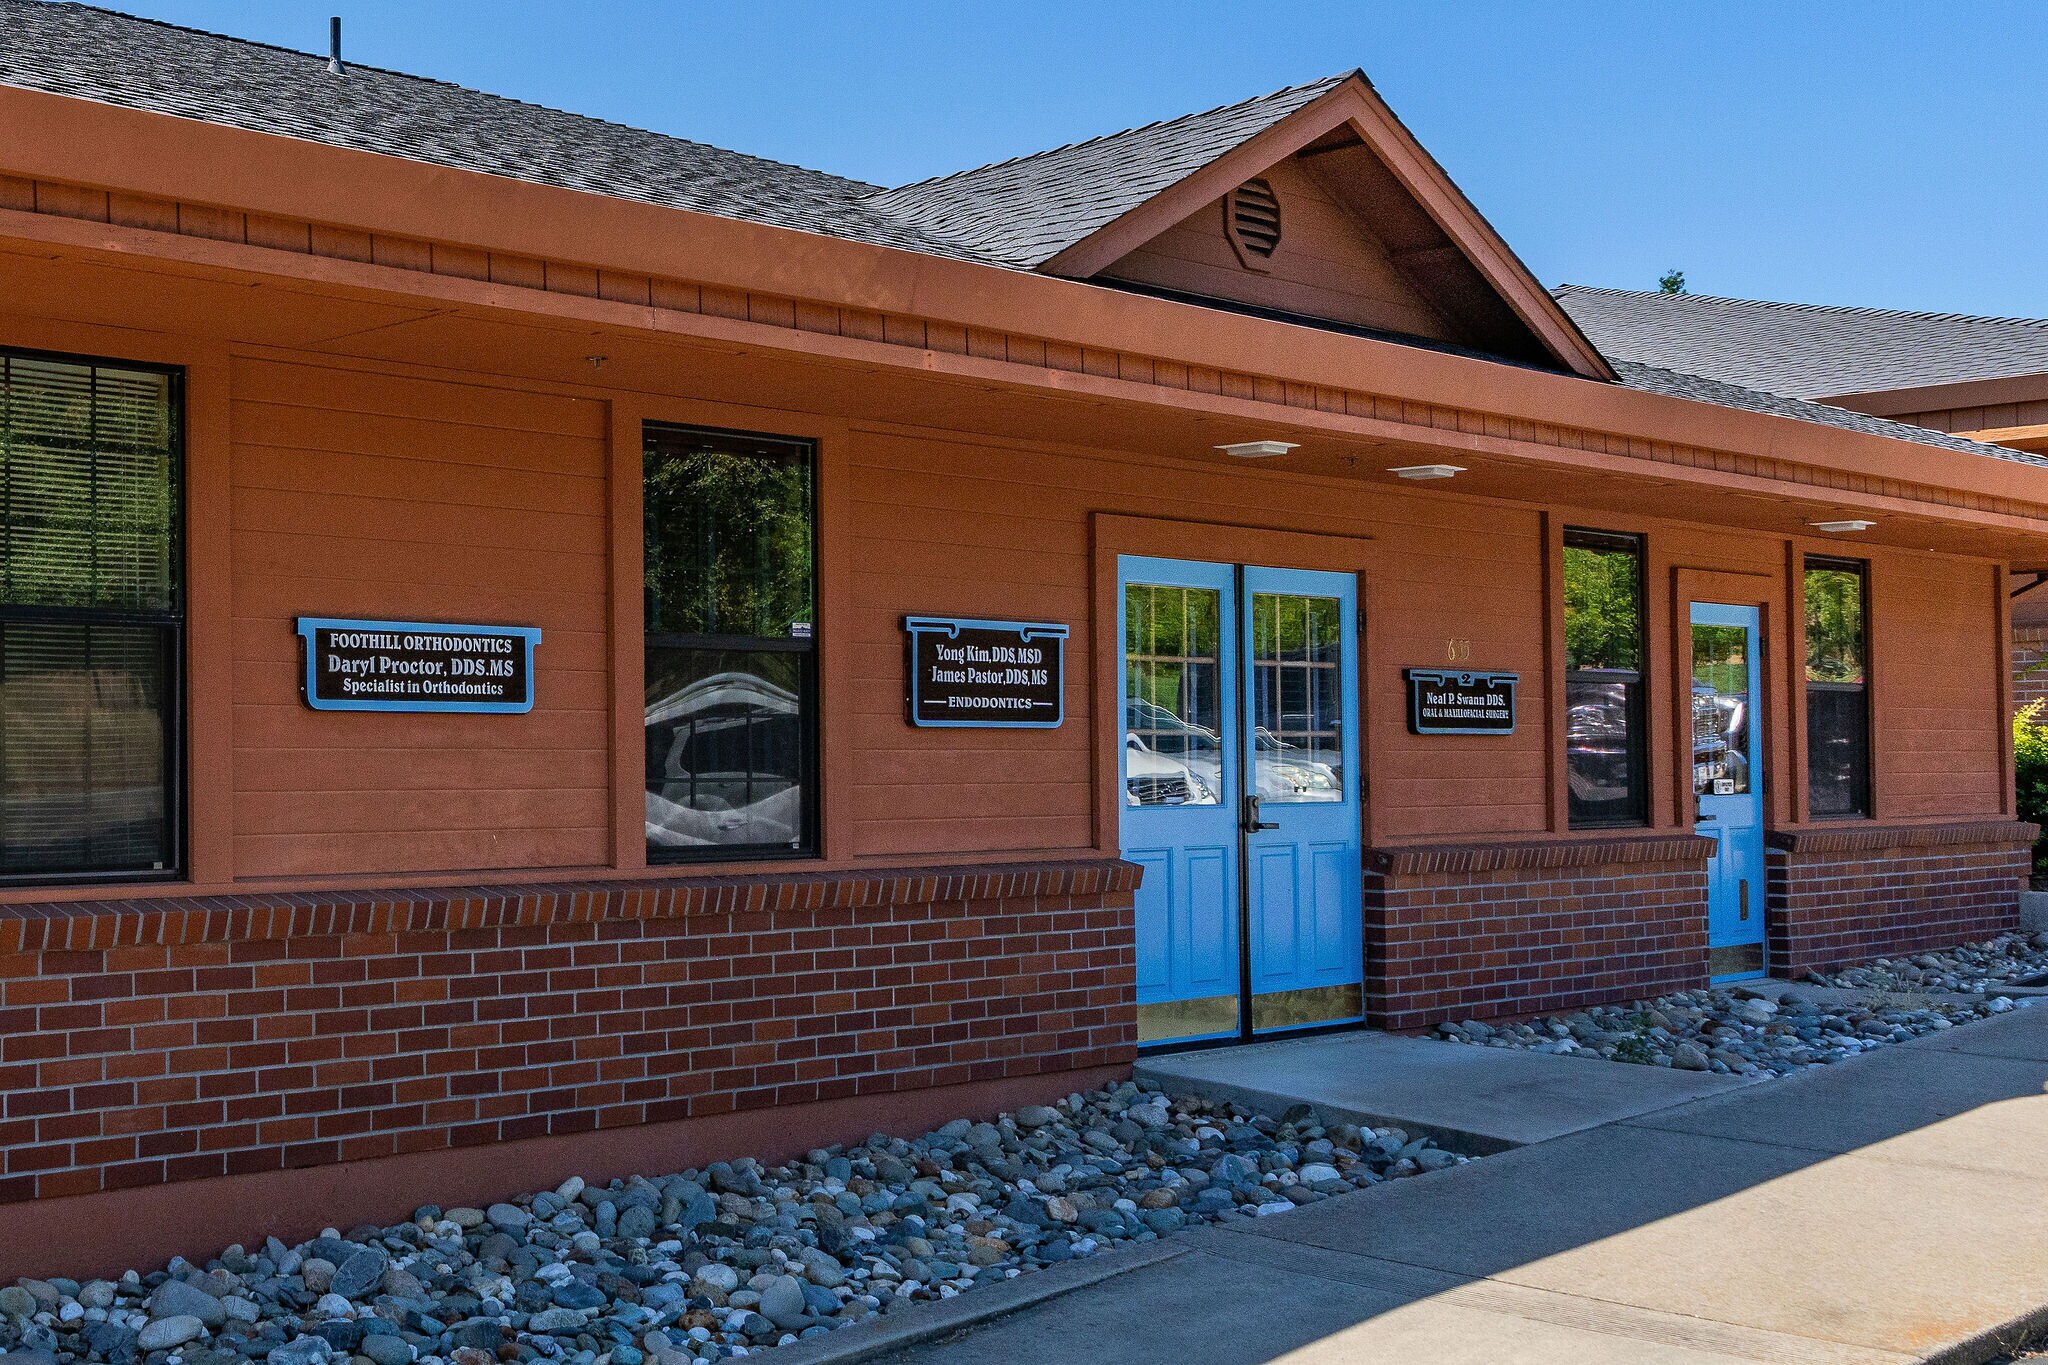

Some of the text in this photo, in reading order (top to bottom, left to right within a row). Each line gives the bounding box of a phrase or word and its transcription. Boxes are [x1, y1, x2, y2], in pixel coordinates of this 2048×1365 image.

[330, 633, 512, 653] FOOTHILL ORTHODONTICS
[936, 644, 965, 665] Yong
[328, 654, 375, 677] Daryl
[380, 656, 448, 677] Proctor,
[932, 666, 966, 684] James
[1461, 673, 1471, 684] 2
[343, 678, 504, 696] Specialist in Orthodontics
[948, 696, 1033, 709] ENDODONTICS
[1426, 692, 1446, 705] Neal
[1448, 692, 1455, 705] P.
[1457, 692, 1485, 706] Swann
[1422, 707, 1438, 718] ORAL
